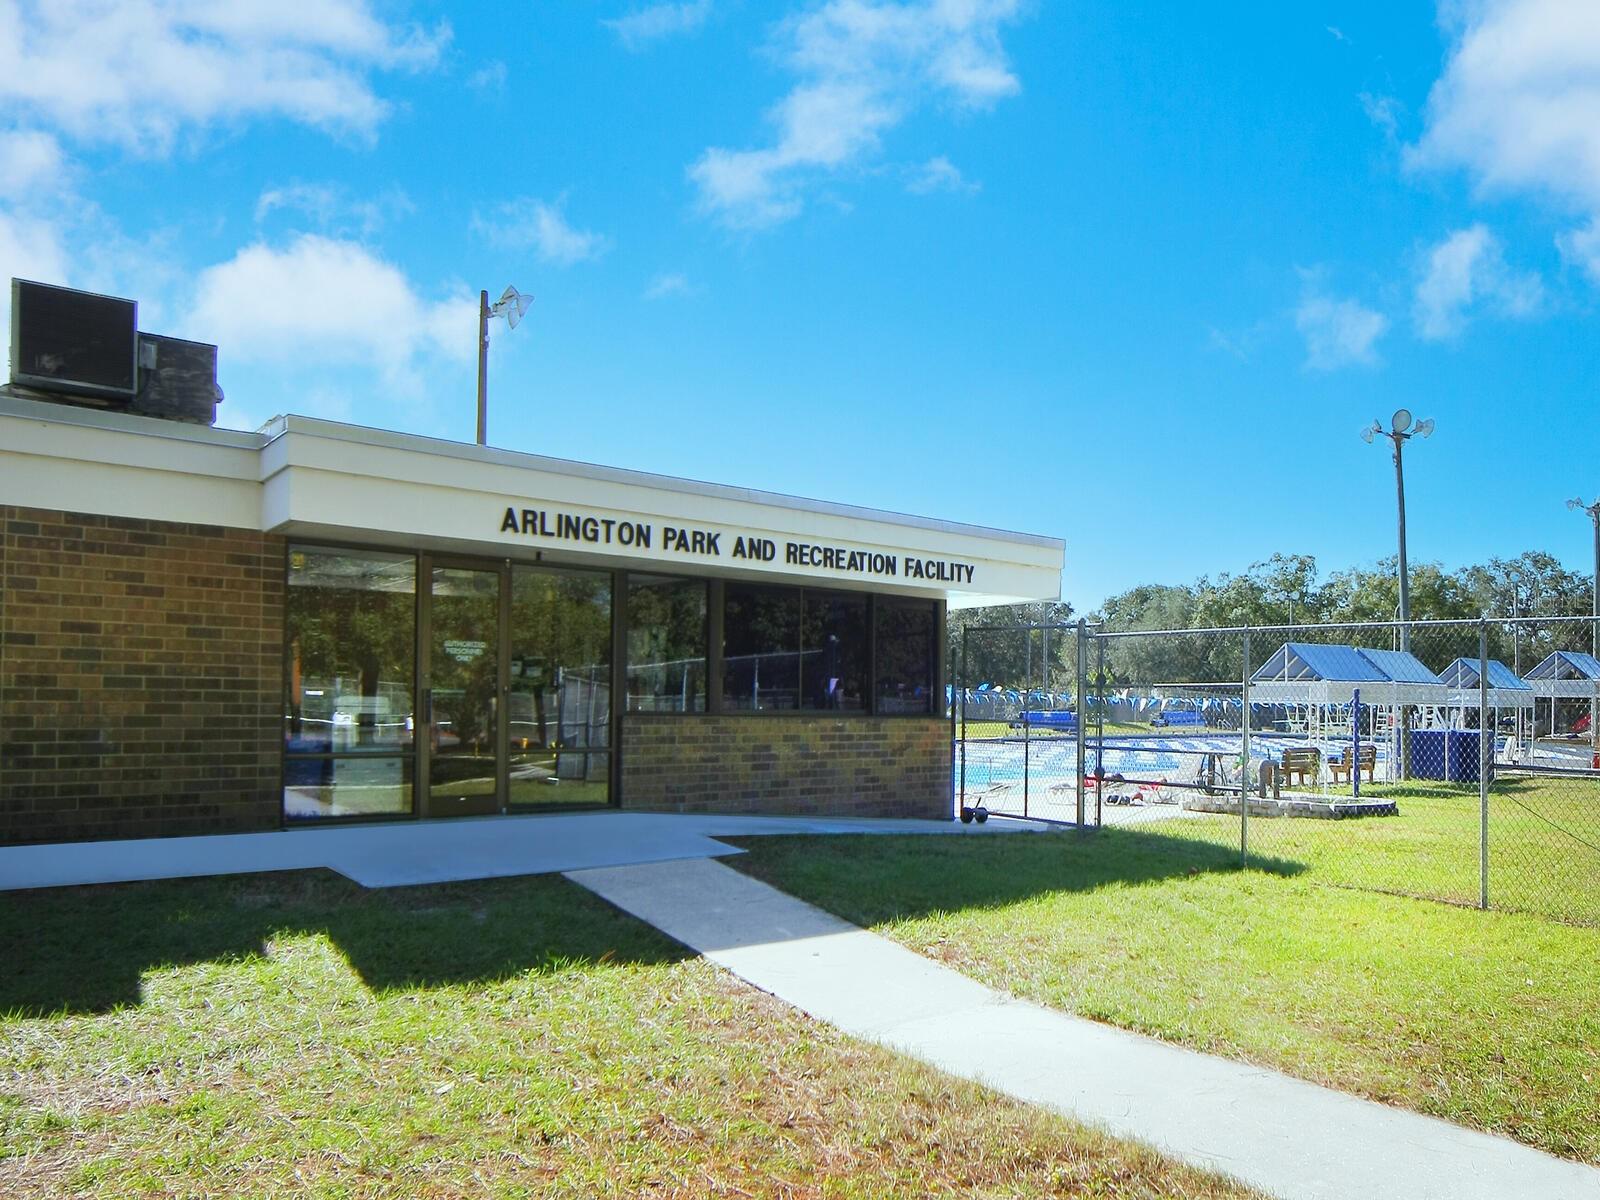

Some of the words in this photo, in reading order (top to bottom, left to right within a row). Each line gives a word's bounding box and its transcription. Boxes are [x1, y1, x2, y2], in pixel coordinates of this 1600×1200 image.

[500, 507, 651, 549] ARLINGTON
[663, 526, 721, 556] PARK
[732, 536, 776, 562] AND
[786, 542, 897, 576] RECREATION
[904, 557, 975, 584] FACILITY
